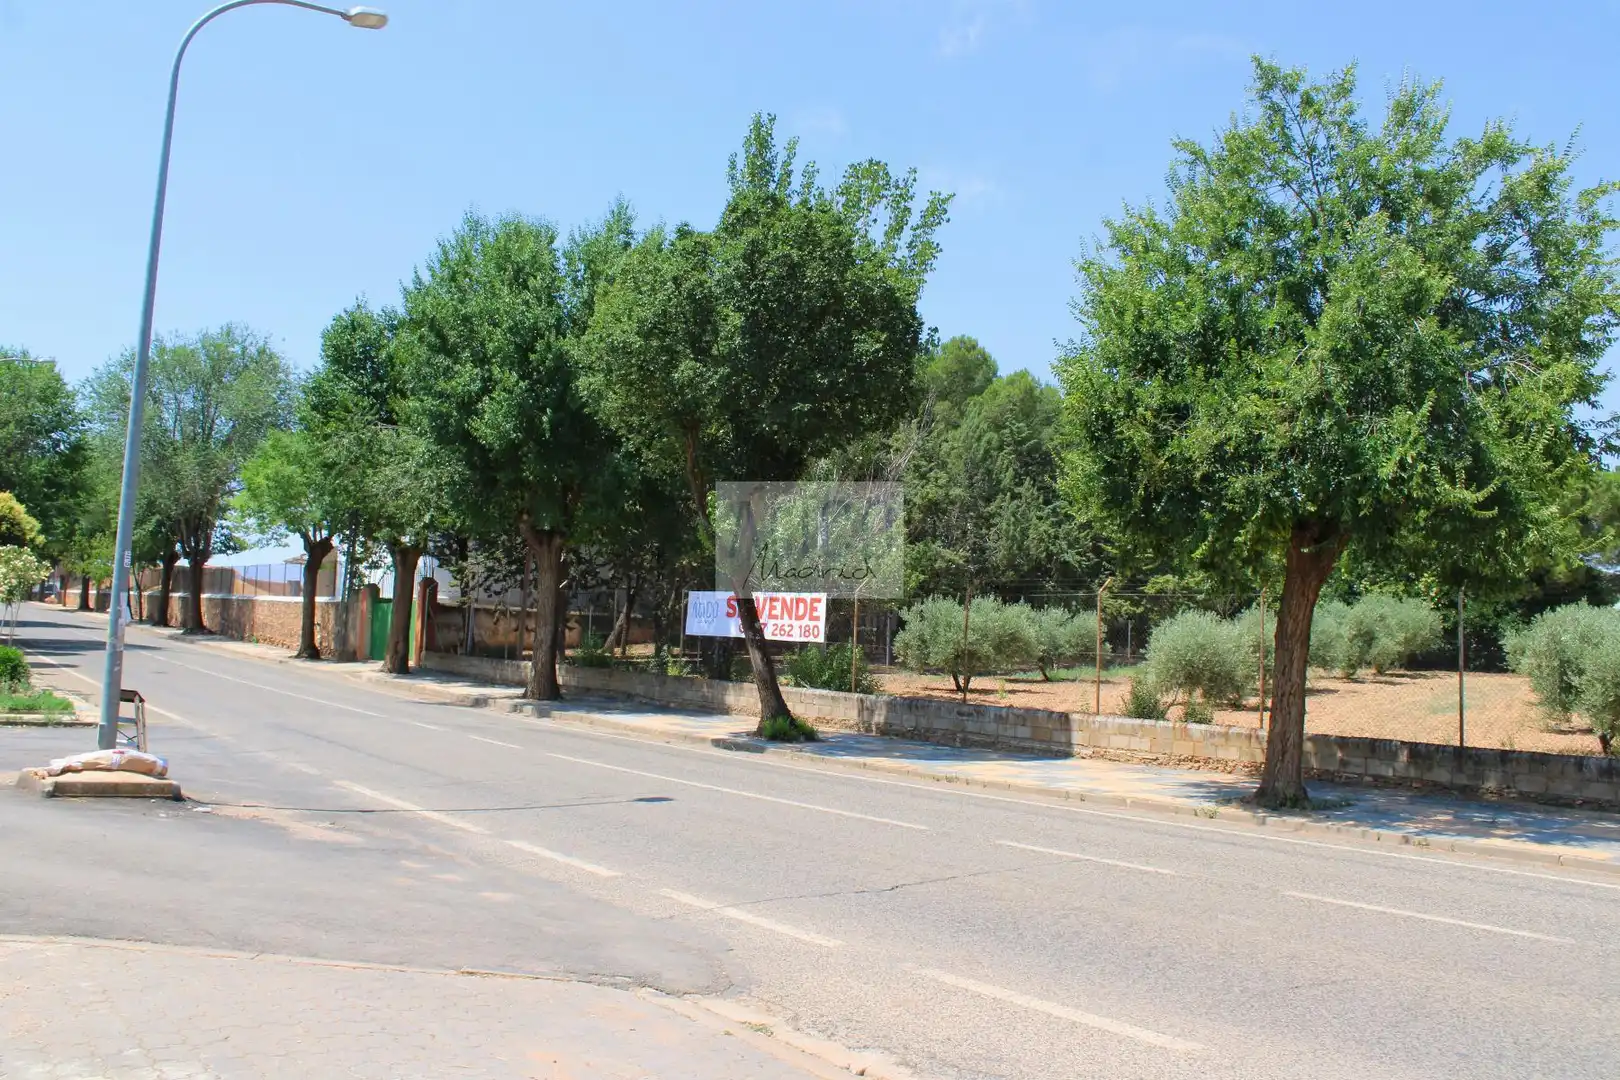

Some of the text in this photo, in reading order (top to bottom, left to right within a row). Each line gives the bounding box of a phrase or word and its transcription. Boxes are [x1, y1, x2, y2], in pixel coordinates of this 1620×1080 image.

[755, 596, 822, 622] VENDE
[771, 623, 794, 638] 262
[798, 624, 820, 639] 180
